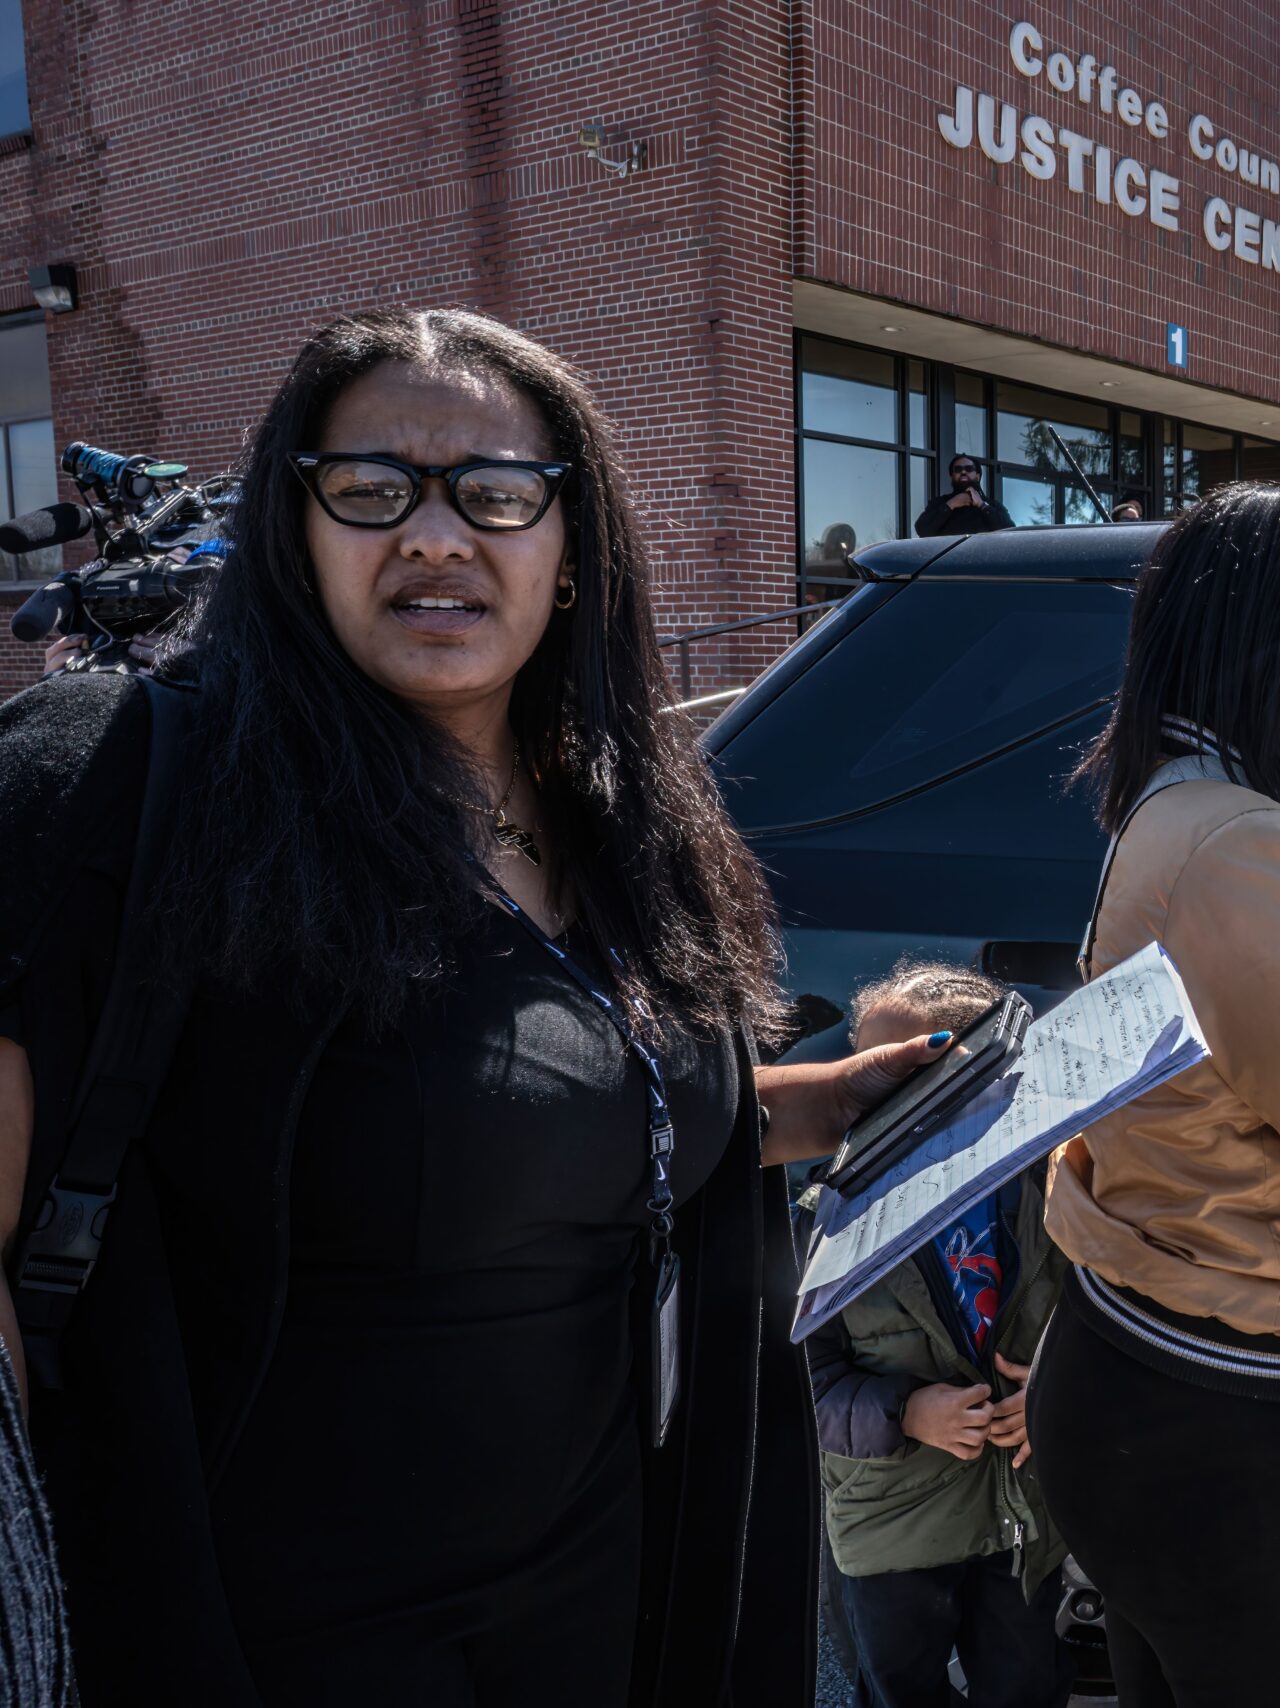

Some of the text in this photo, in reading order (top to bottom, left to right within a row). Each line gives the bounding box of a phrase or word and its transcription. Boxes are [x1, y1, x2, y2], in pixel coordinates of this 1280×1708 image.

[1009, 21, 1169, 139] Coffee
[937, 84, 1180, 233] JUSTICE
[1171, 327, 1183, 365] 1
